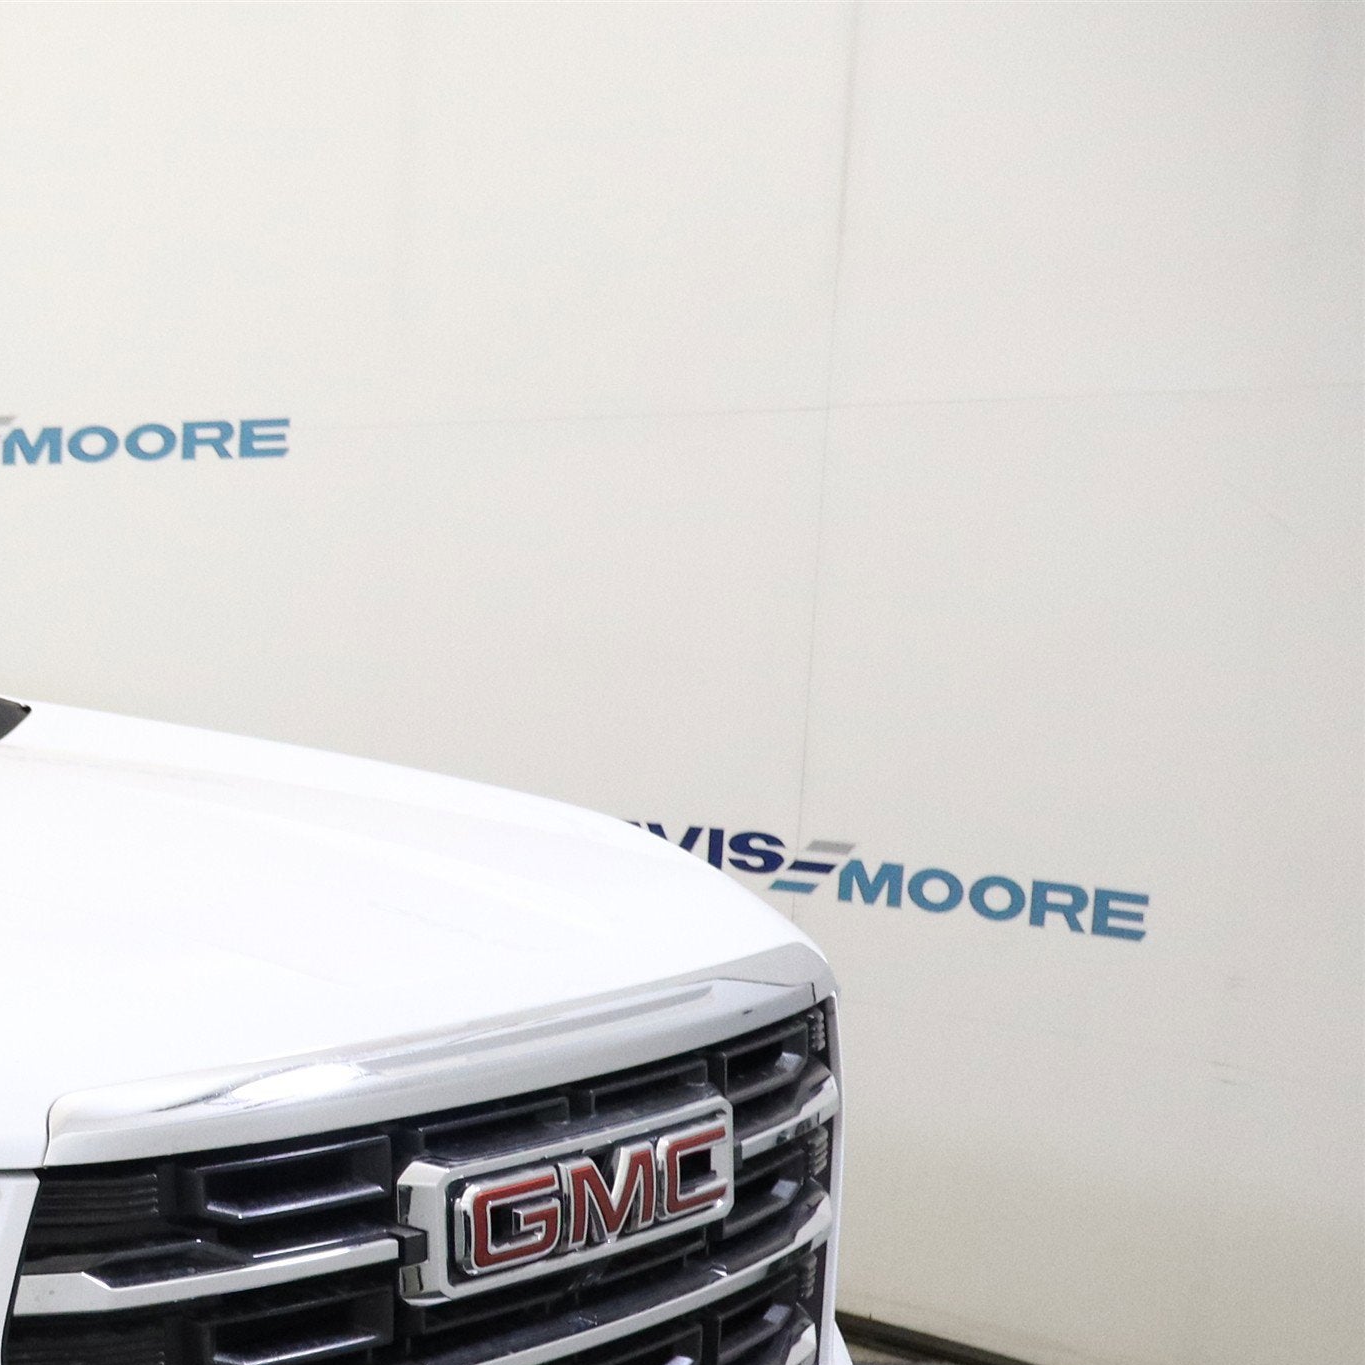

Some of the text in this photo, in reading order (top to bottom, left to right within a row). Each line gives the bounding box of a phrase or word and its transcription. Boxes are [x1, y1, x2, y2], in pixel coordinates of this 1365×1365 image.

[1, 417, 291, 466] MOORE
[626, 820, 1150, 942] VIS MOORE
[459, 1122, 729, 1275] GMC
